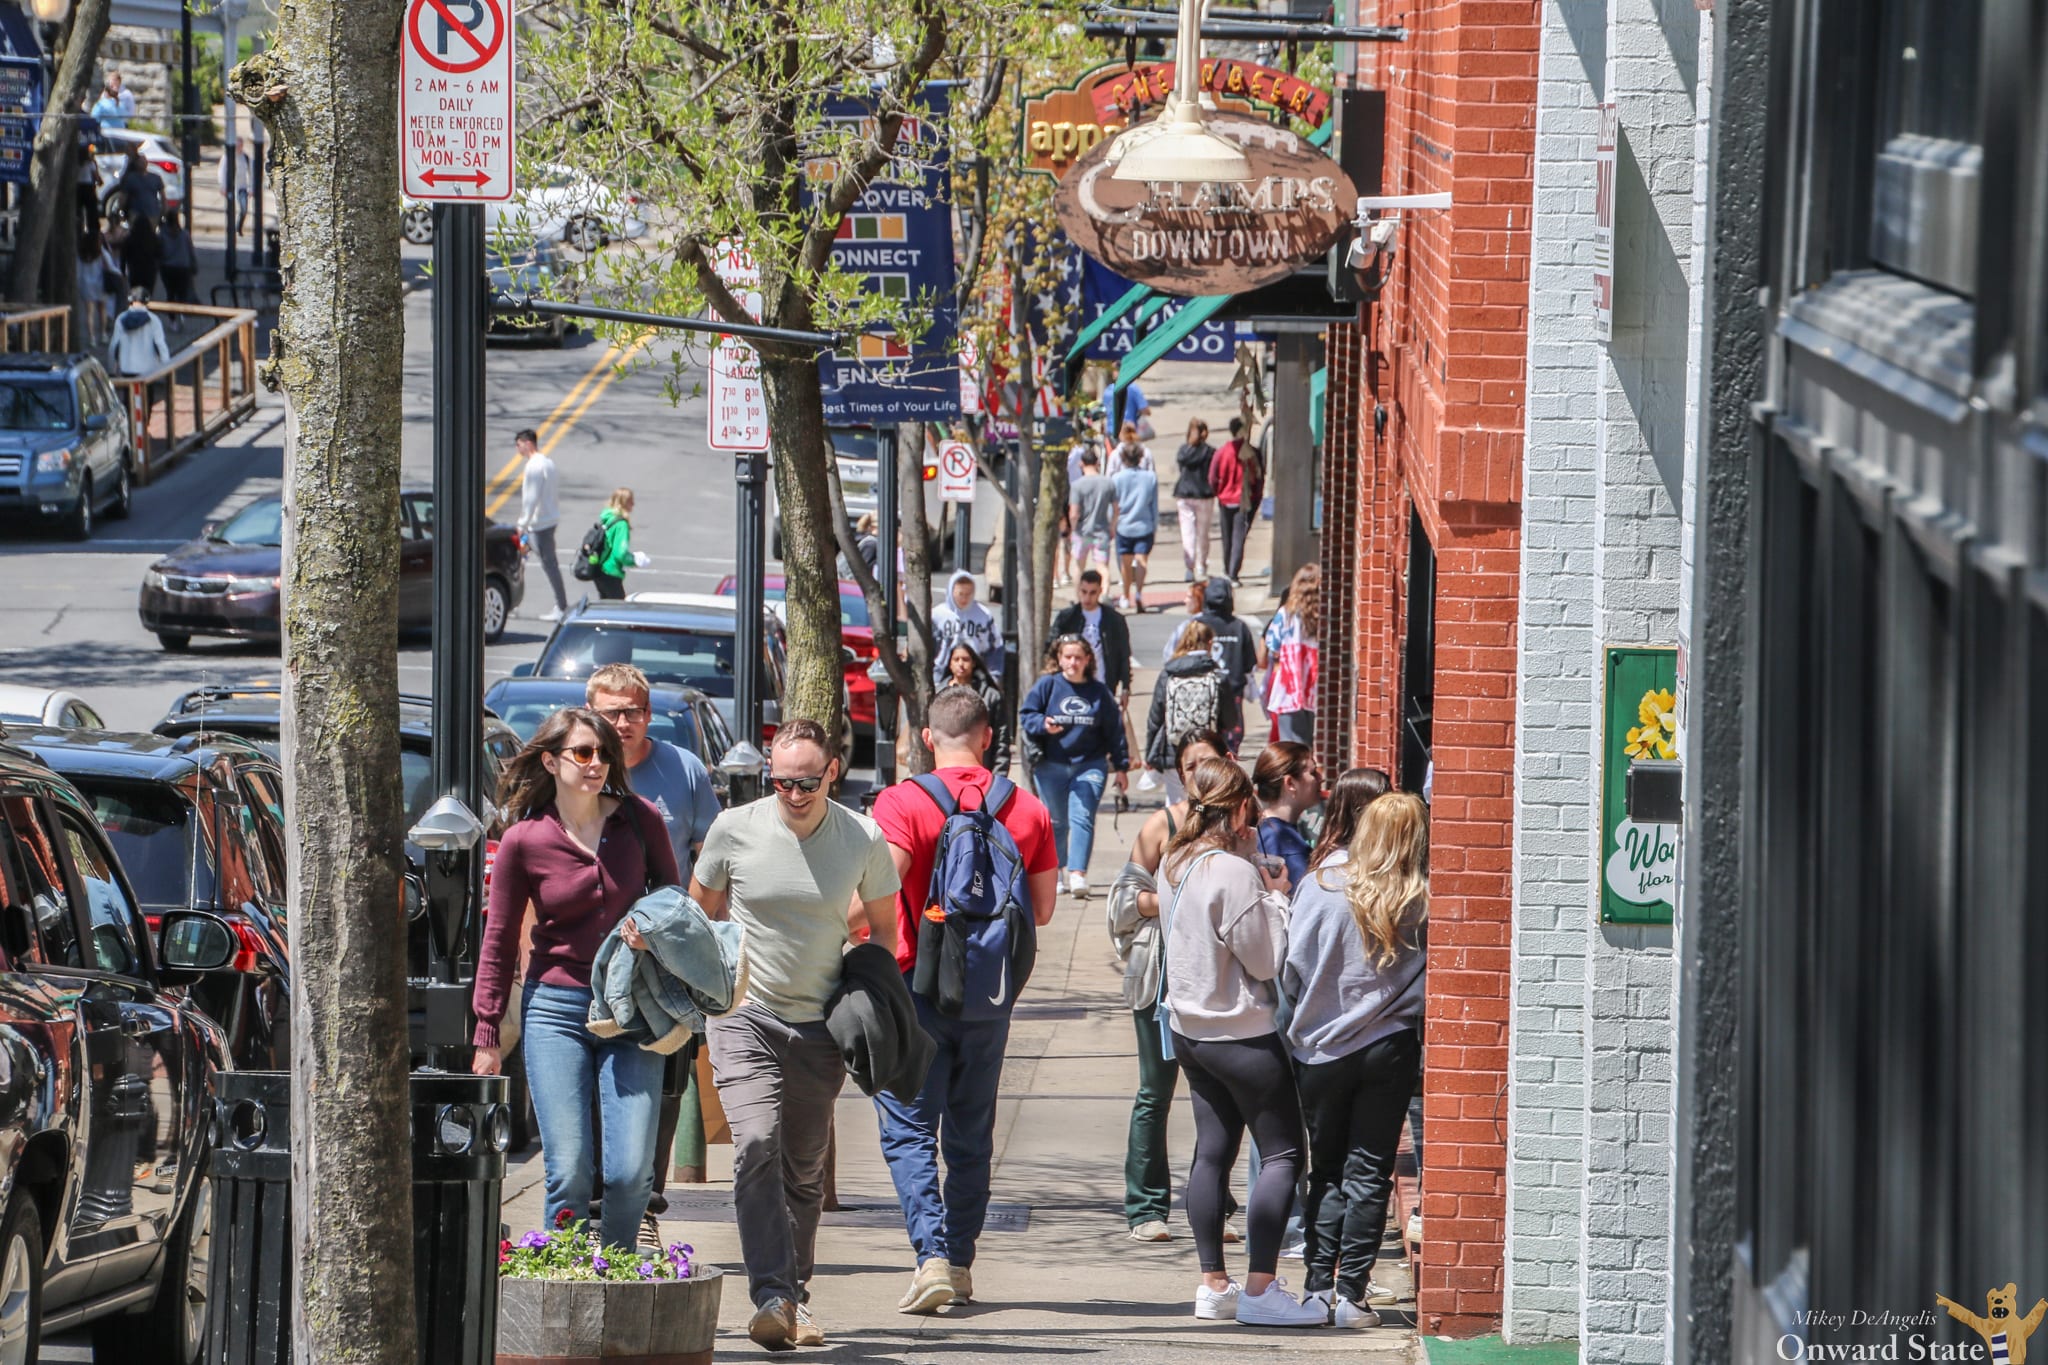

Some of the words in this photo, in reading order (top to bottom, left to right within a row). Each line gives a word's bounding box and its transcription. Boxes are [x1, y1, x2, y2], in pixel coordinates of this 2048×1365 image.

[415, 77, 423, 92] 2
[429, 78, 447, 92] AM
[466, 80, 474, 94] 6
[480, 80, 498, 94] AM
[1228, 65, 1308, 112] BEER
[439, 97, 473, 112] DAILY
[410, 115, 444, 129] METER
[449, 116, 503, 131] ENFORCED
[412, 129, 424, 148] 10
[427, 133, 446, 148] AM
[464, 130, 477, 150] 10
[482, 135, 501, 150] PM
[421, 148, 490, 168] MON-SAT
[1078, 158, 1338, 224] CHAMPS
[1132, 228, 1290, 261] DOWNTOWN
[1098, 332, 1225, 354] TAOO
[725, 365, 757, 379] LANES
[837, 367, 910, 385] ENJOY
[849, 401, 884, 413] Times
[887, 401, 899, 413] of
[904, 401, 930, 412] Your
[934, 400, 957, 411] Life
